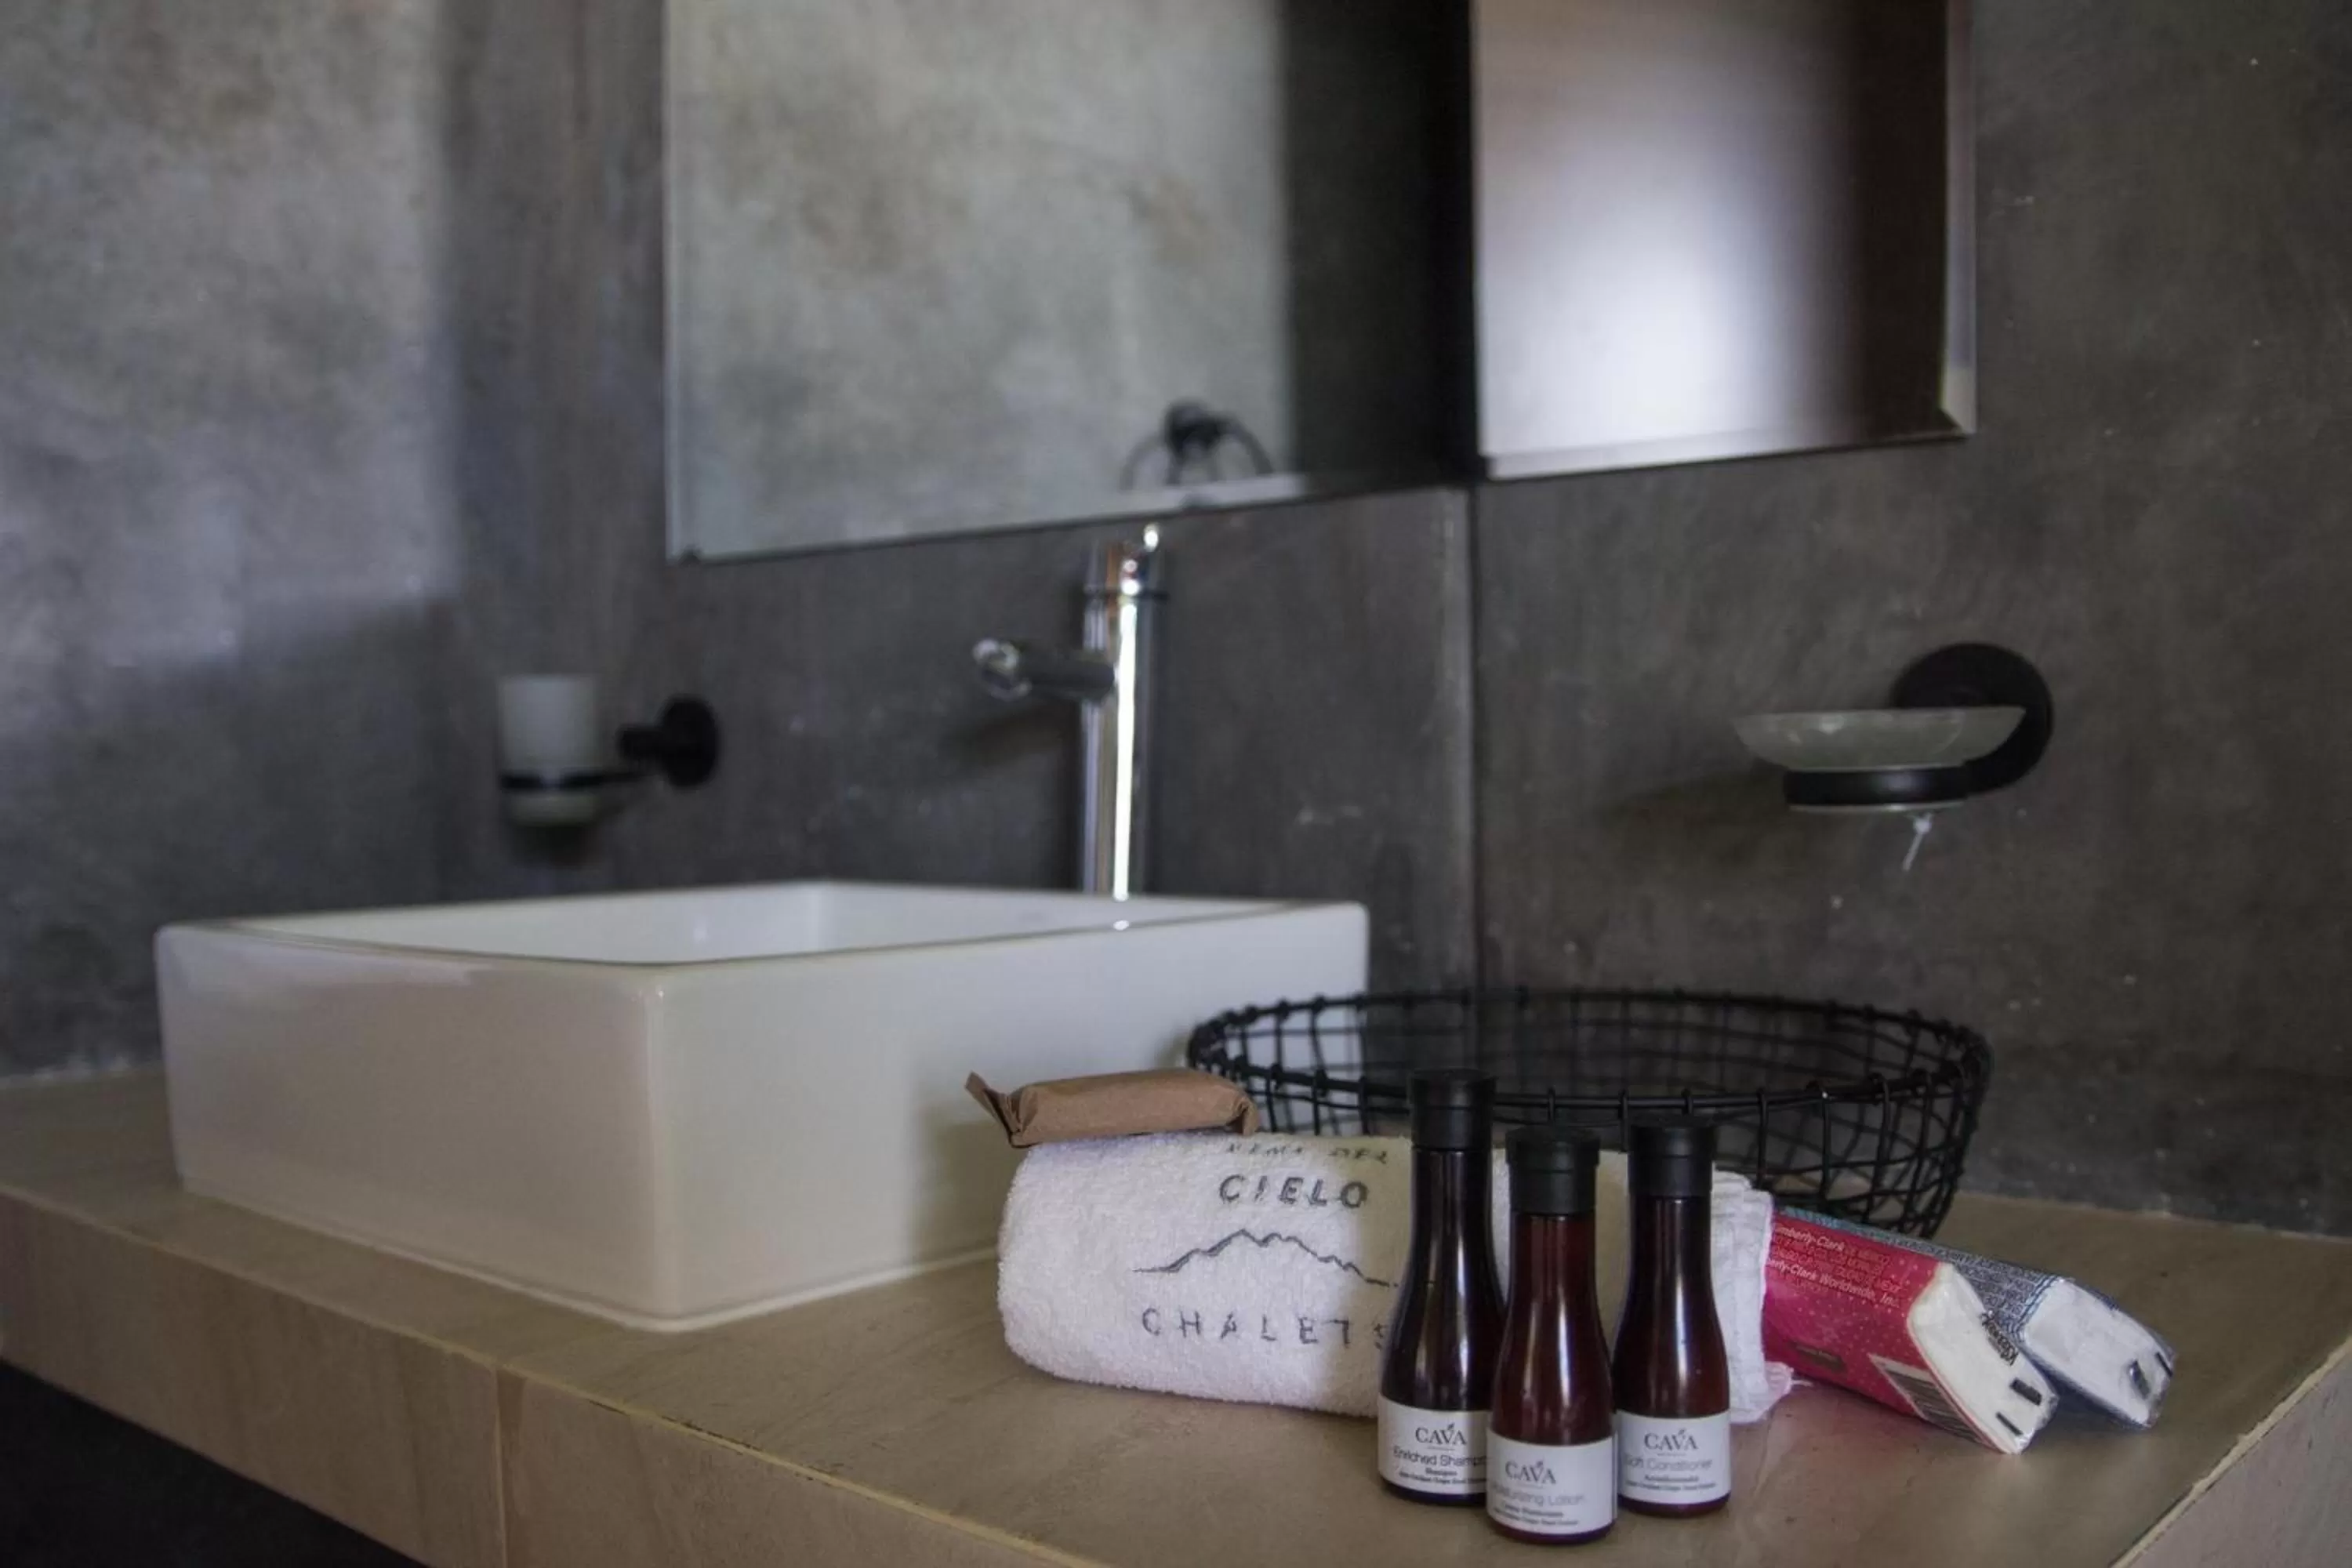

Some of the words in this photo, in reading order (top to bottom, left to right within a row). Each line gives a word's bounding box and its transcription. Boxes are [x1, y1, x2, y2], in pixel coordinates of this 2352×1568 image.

[1218, 1174, 1370, 1209] CIELO
[1415, 1423, 1467, 1445] CAVA
[1644, 1429, 1699, 1451] CAVA
[1393, 1445, 1437, 1465] Enriched
[1505, 1461, 1556, 1484] CAVA
